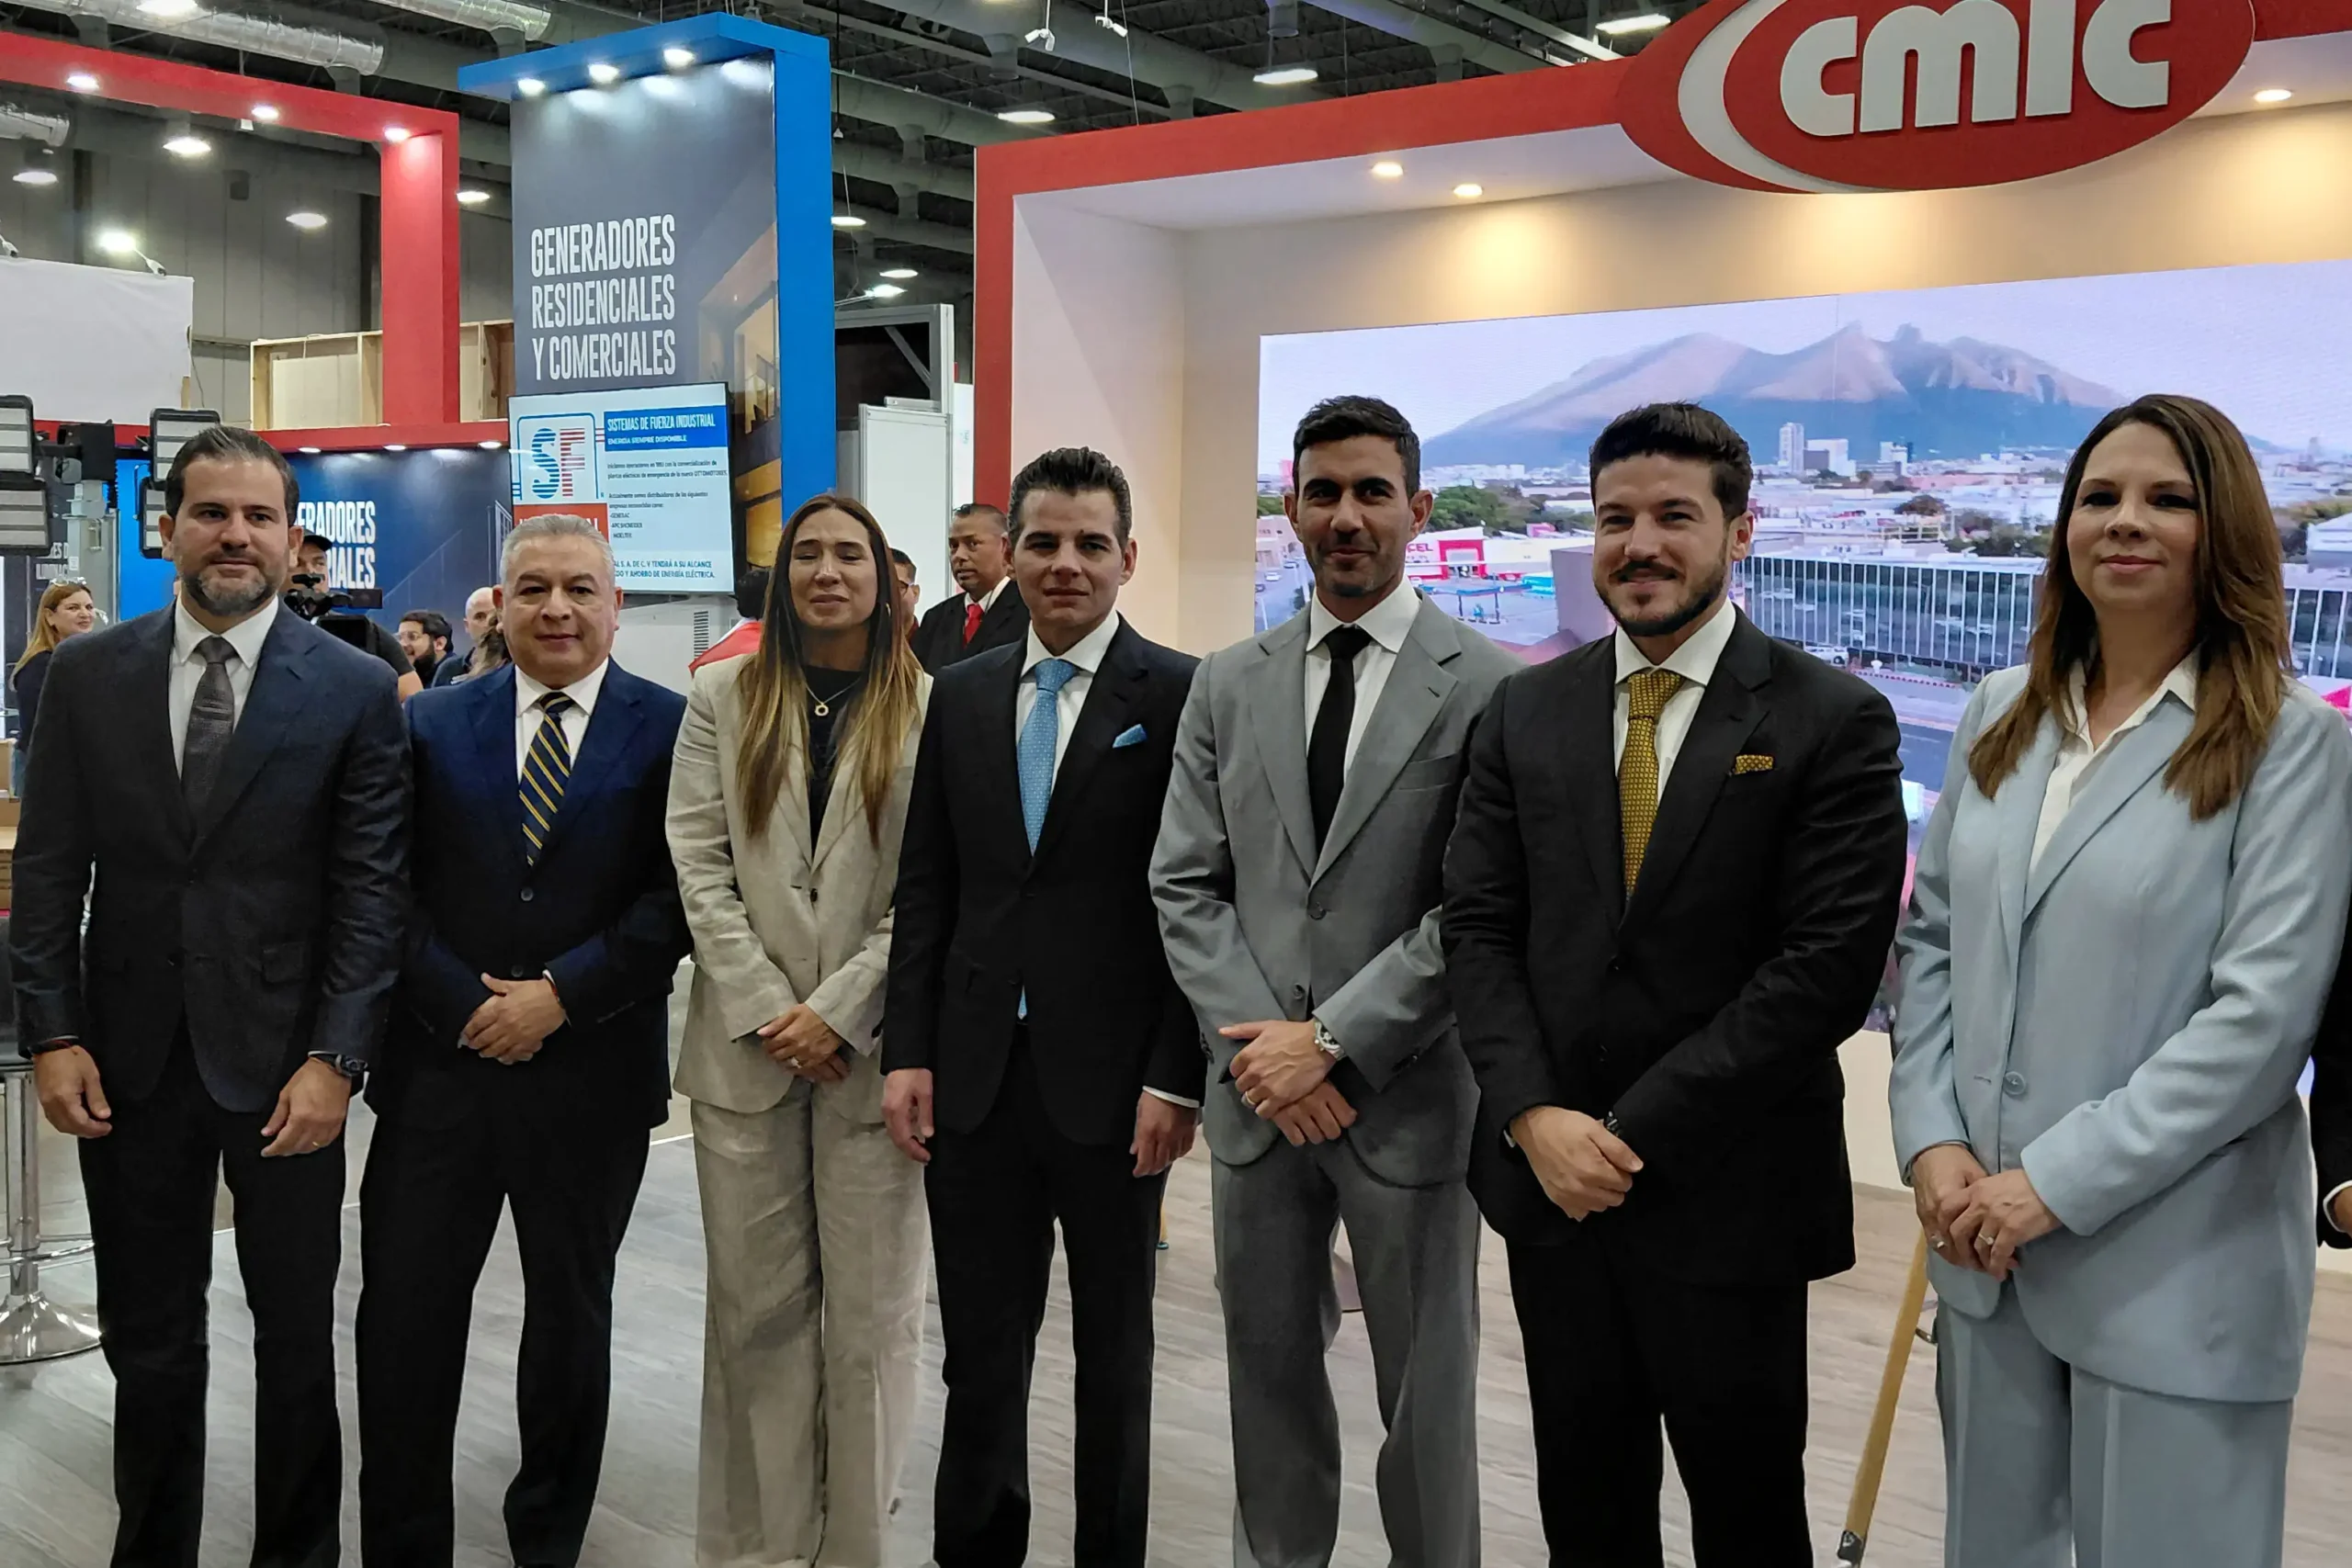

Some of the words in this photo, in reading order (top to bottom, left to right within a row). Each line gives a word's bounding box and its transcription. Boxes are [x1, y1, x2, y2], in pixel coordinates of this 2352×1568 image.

[531, 214, 675, 277] GENERADORES
[531, 274, 675, 329] RESIDENCIALES
[532, 337, 544, 380] Y
[549, 329, 676, 380] COMERCIALES
[607, 417, 639, 432] SISTEMAS
[640, 417, 649, 430] DE
[650, 415, 675, 429] FUERZA
[675, 413, 716, 428] INDUSTRIAL
[631, 435, 654, 444] SIEMPRE
[655, 434, 687, 443] DISPONIBLE
[294, 500, 376, 544] ERADORES
